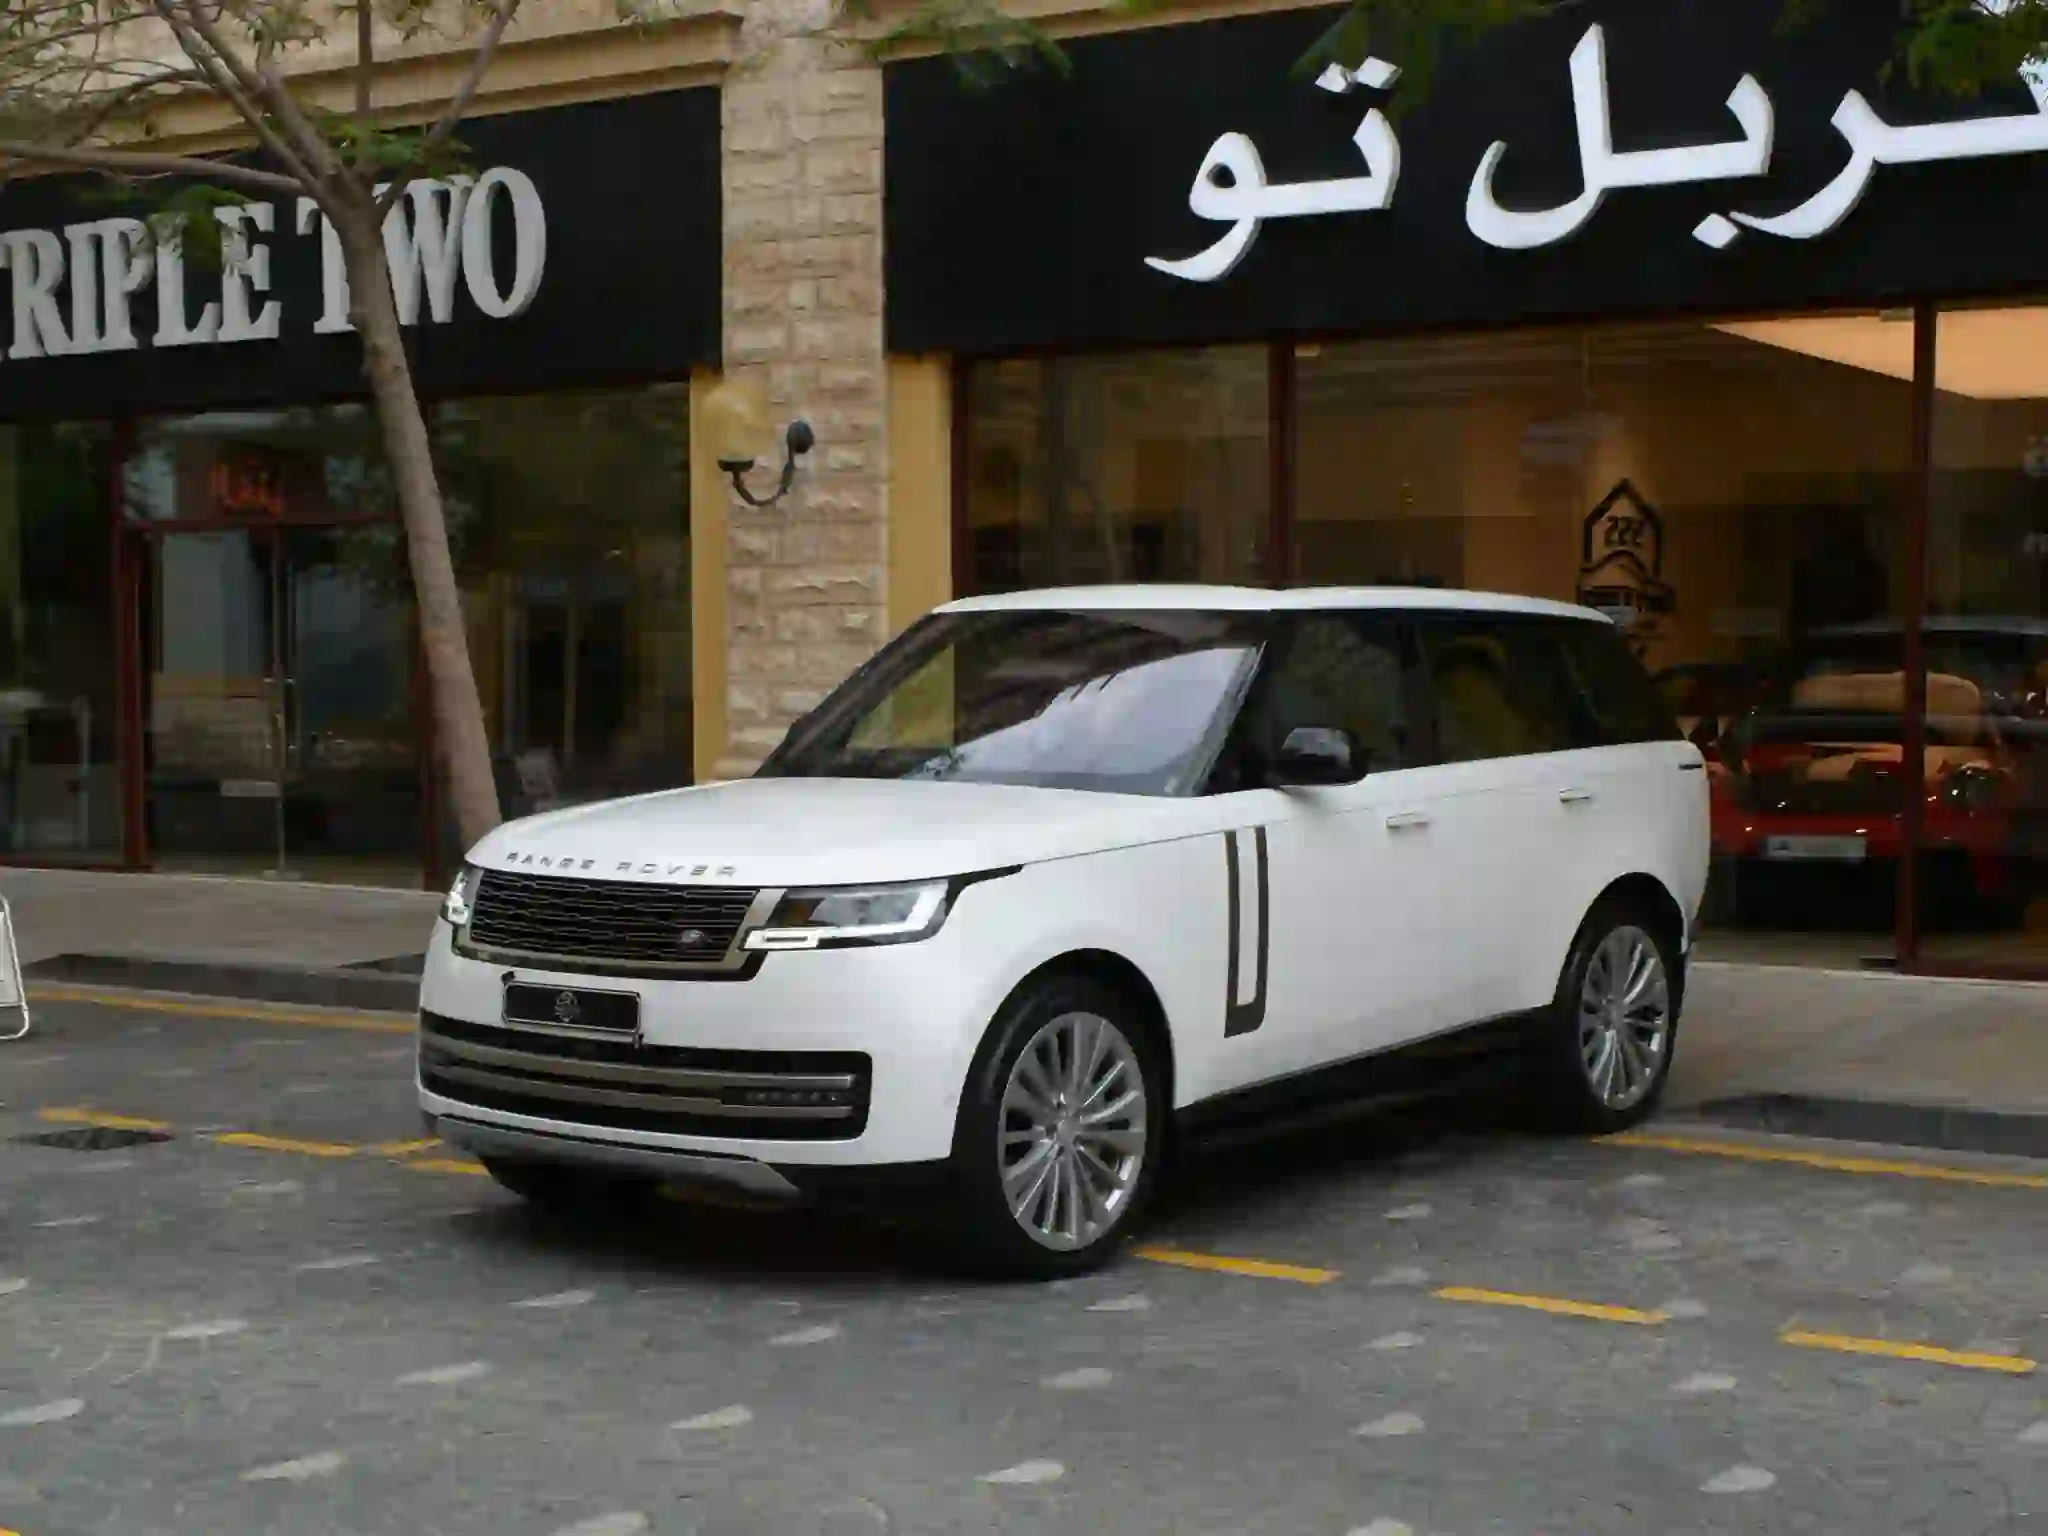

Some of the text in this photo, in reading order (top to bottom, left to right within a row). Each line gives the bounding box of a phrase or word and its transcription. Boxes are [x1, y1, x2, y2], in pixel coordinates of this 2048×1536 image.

[0, 165, 546, 361] RIPLE TWO
[1144, 55, 1401, 283] تو
[506, 851, 737, 877] RANGE ROVER
